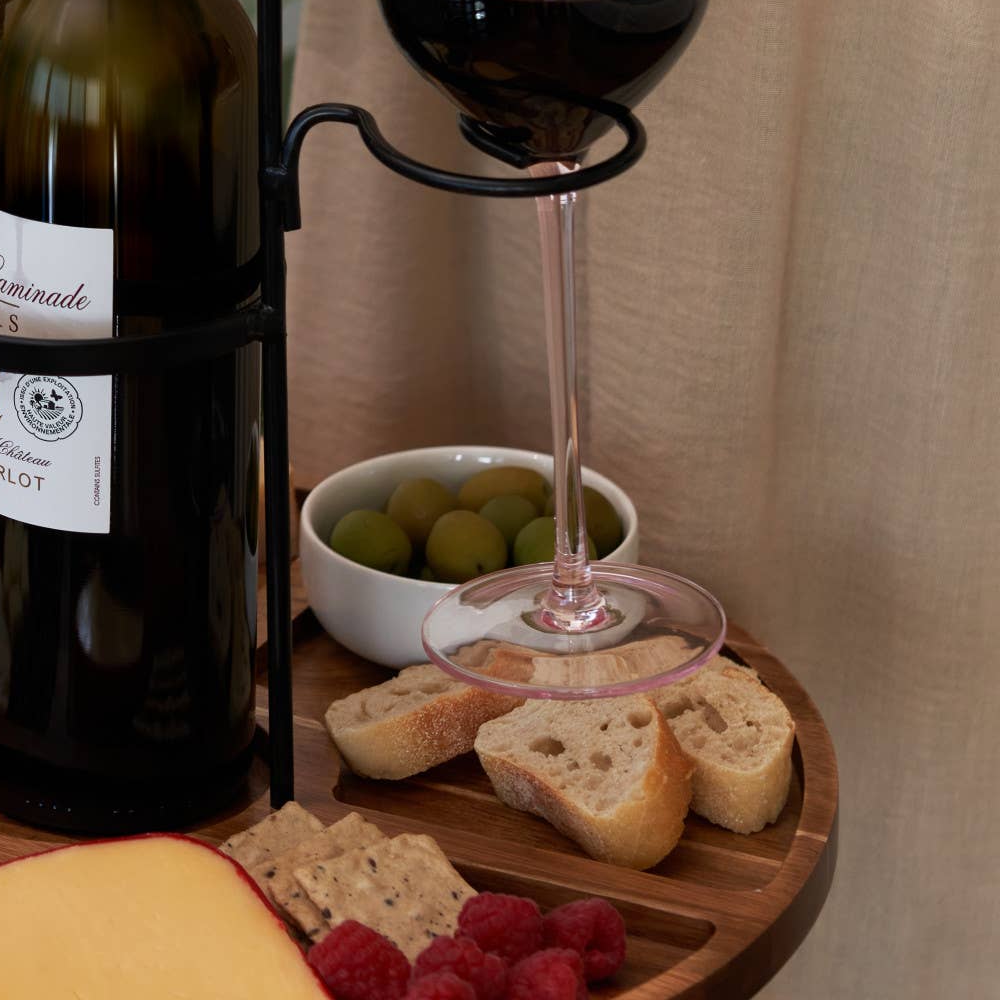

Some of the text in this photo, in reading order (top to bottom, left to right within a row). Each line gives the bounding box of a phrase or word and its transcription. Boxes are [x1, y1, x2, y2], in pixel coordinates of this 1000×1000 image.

[43, 376, 76, 409] EXPLOITATION
[20, 404, 75, 435] ENVIRONNEMENTALE
[26, 409, 67, 429] HAUTE VALEUR
